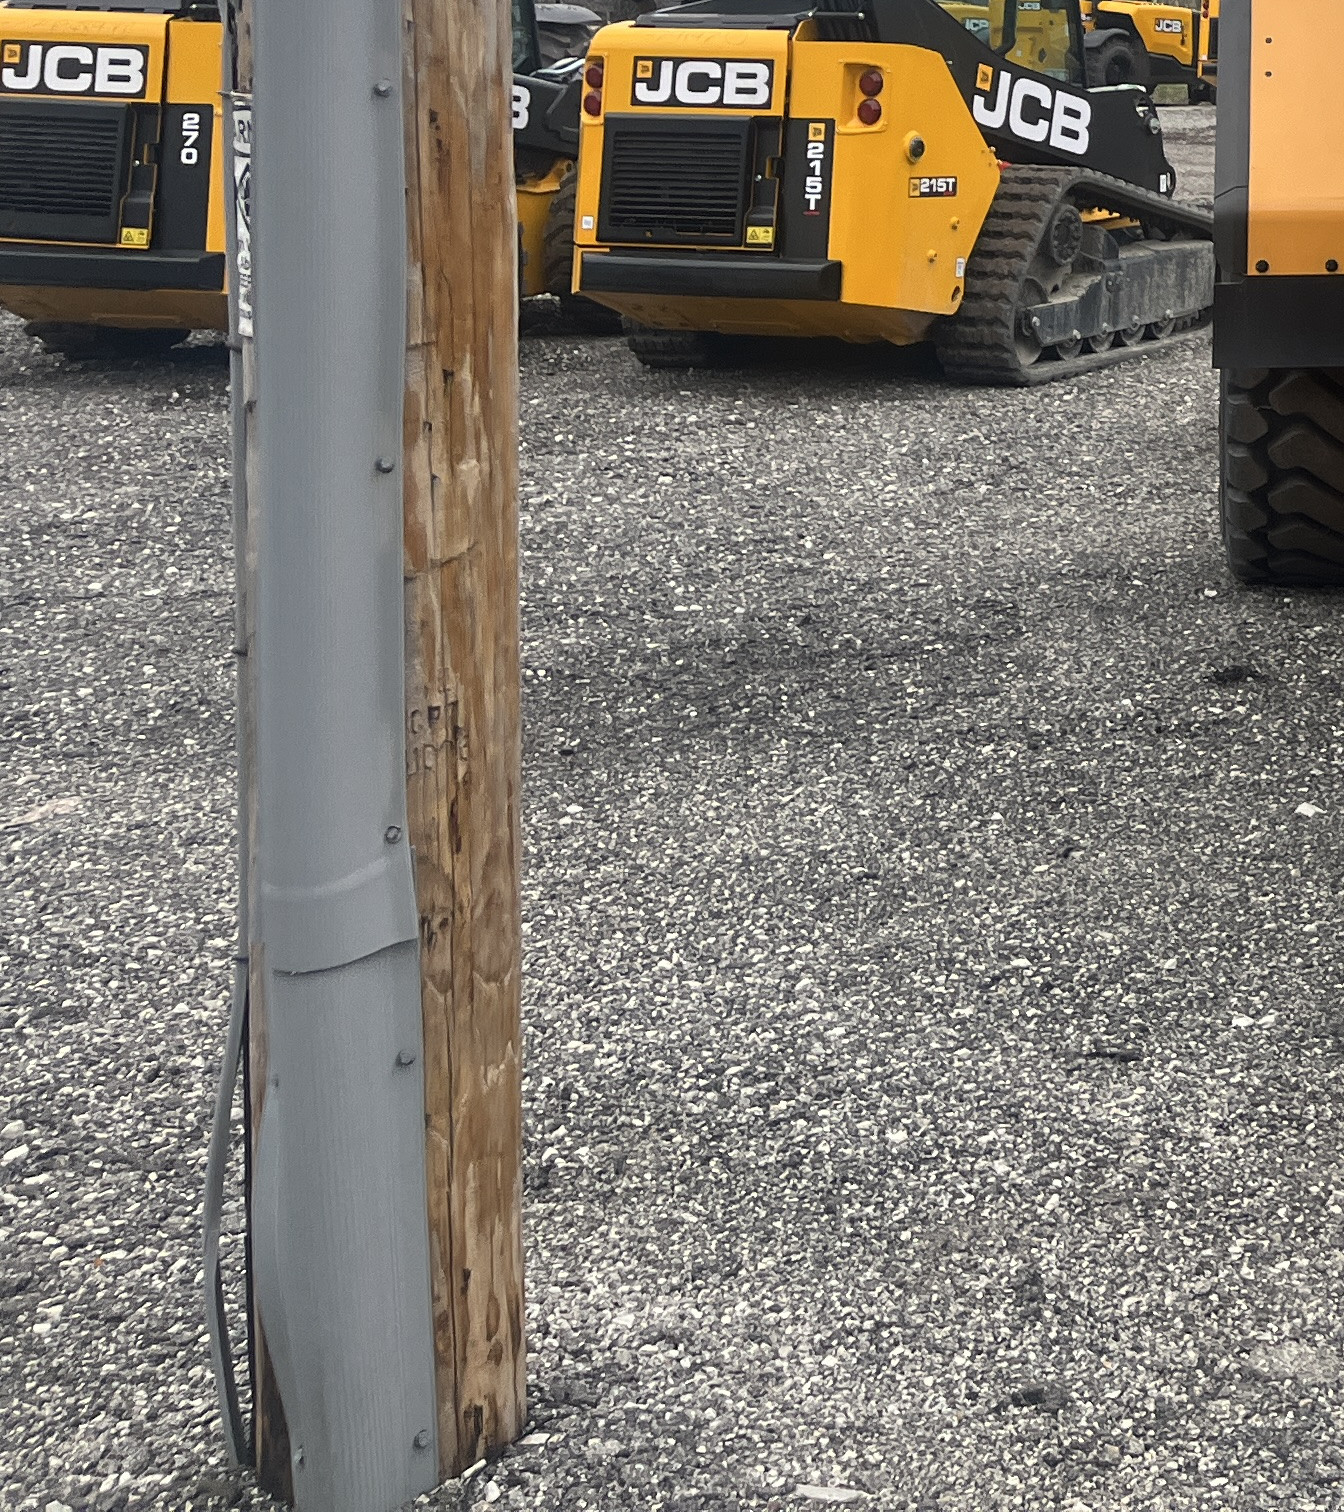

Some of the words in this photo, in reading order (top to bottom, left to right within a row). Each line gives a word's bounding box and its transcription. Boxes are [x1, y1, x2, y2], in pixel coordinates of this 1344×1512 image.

[1155, 20, 1183, 33] JCB
[2, 44, 144, 94] JCB
[635, 60, 770, 106] JCB
[972, 70, 1091, 154] JCB
[920, 177, 956, 192] 215T
